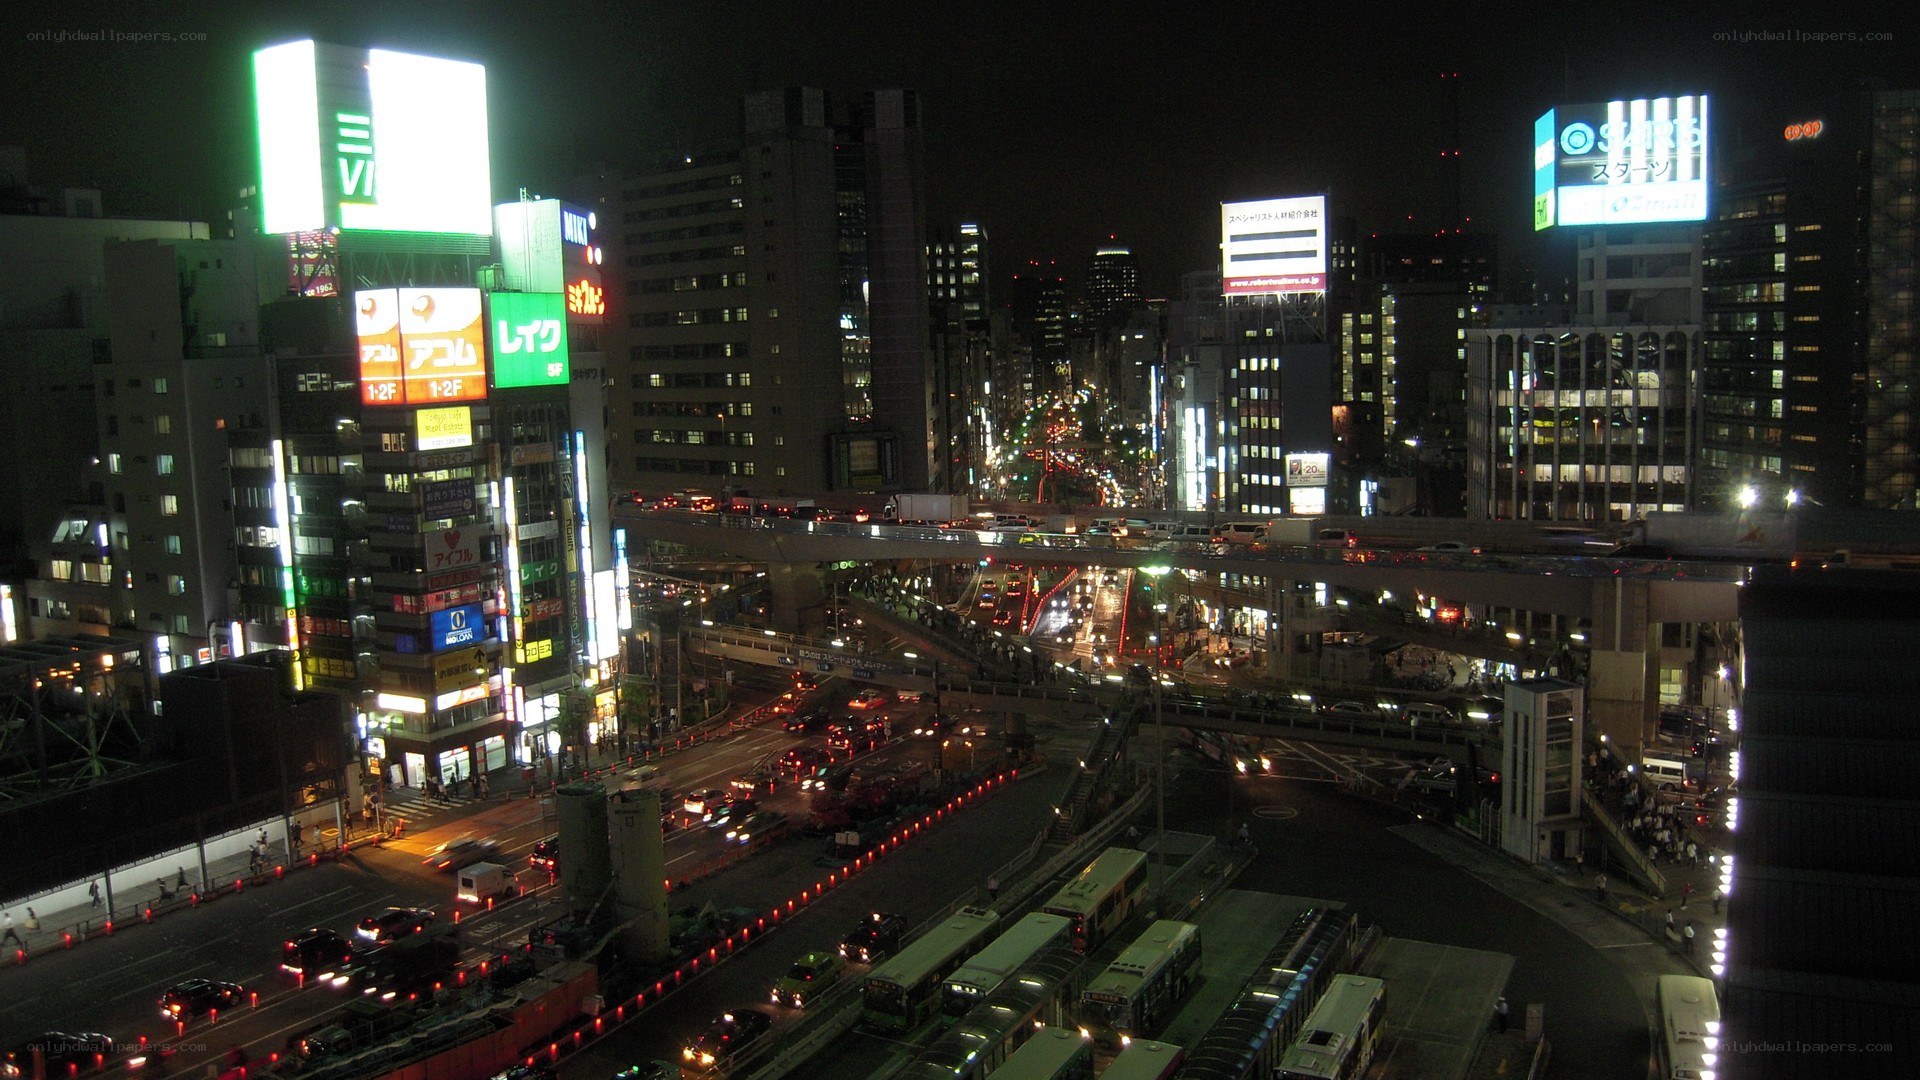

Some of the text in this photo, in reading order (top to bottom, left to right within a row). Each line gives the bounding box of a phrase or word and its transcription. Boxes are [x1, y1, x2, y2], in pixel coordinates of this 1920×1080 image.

[1593, 161, 1670, 180] スターツ
[564, 210, 588, 246] MIKI
[316, 282, 334, 294] 1962
[498, 319, 562, 354] レイク
[361, 343, 399, 364] アコム
[408, 338, 478, 371] アコム
[547, 362, 564, 377] 5F
[435, 548, 475, 568] アイフル
[520, 562, 558, 581] レイク
